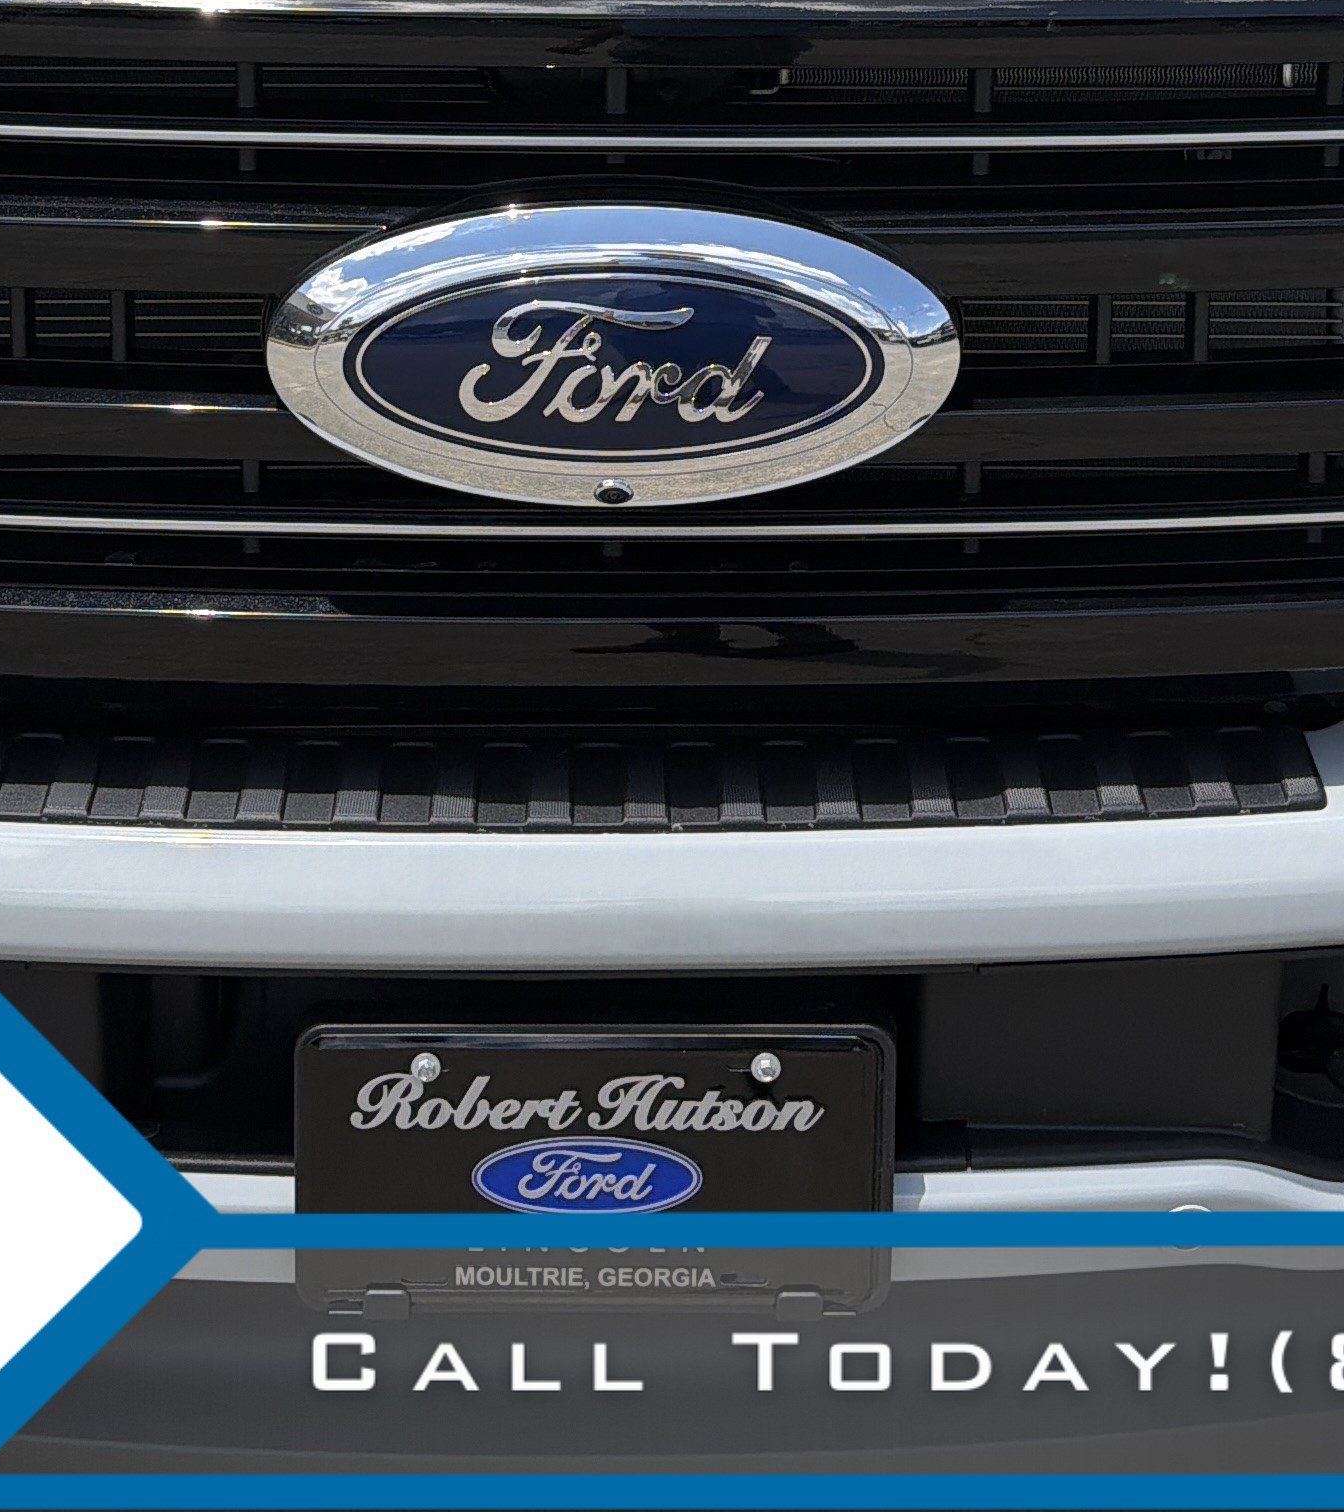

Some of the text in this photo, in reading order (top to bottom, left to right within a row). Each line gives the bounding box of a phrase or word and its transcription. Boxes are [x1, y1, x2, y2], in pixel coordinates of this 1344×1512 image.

[457, 299, 773, 424] Ford
[349, 1072, 826, 1132] Robert Hutson
[517, 1149, 657, 1202] Ford
[455, 1266, 717, 1290] MOULTRIE, GEORGIA
